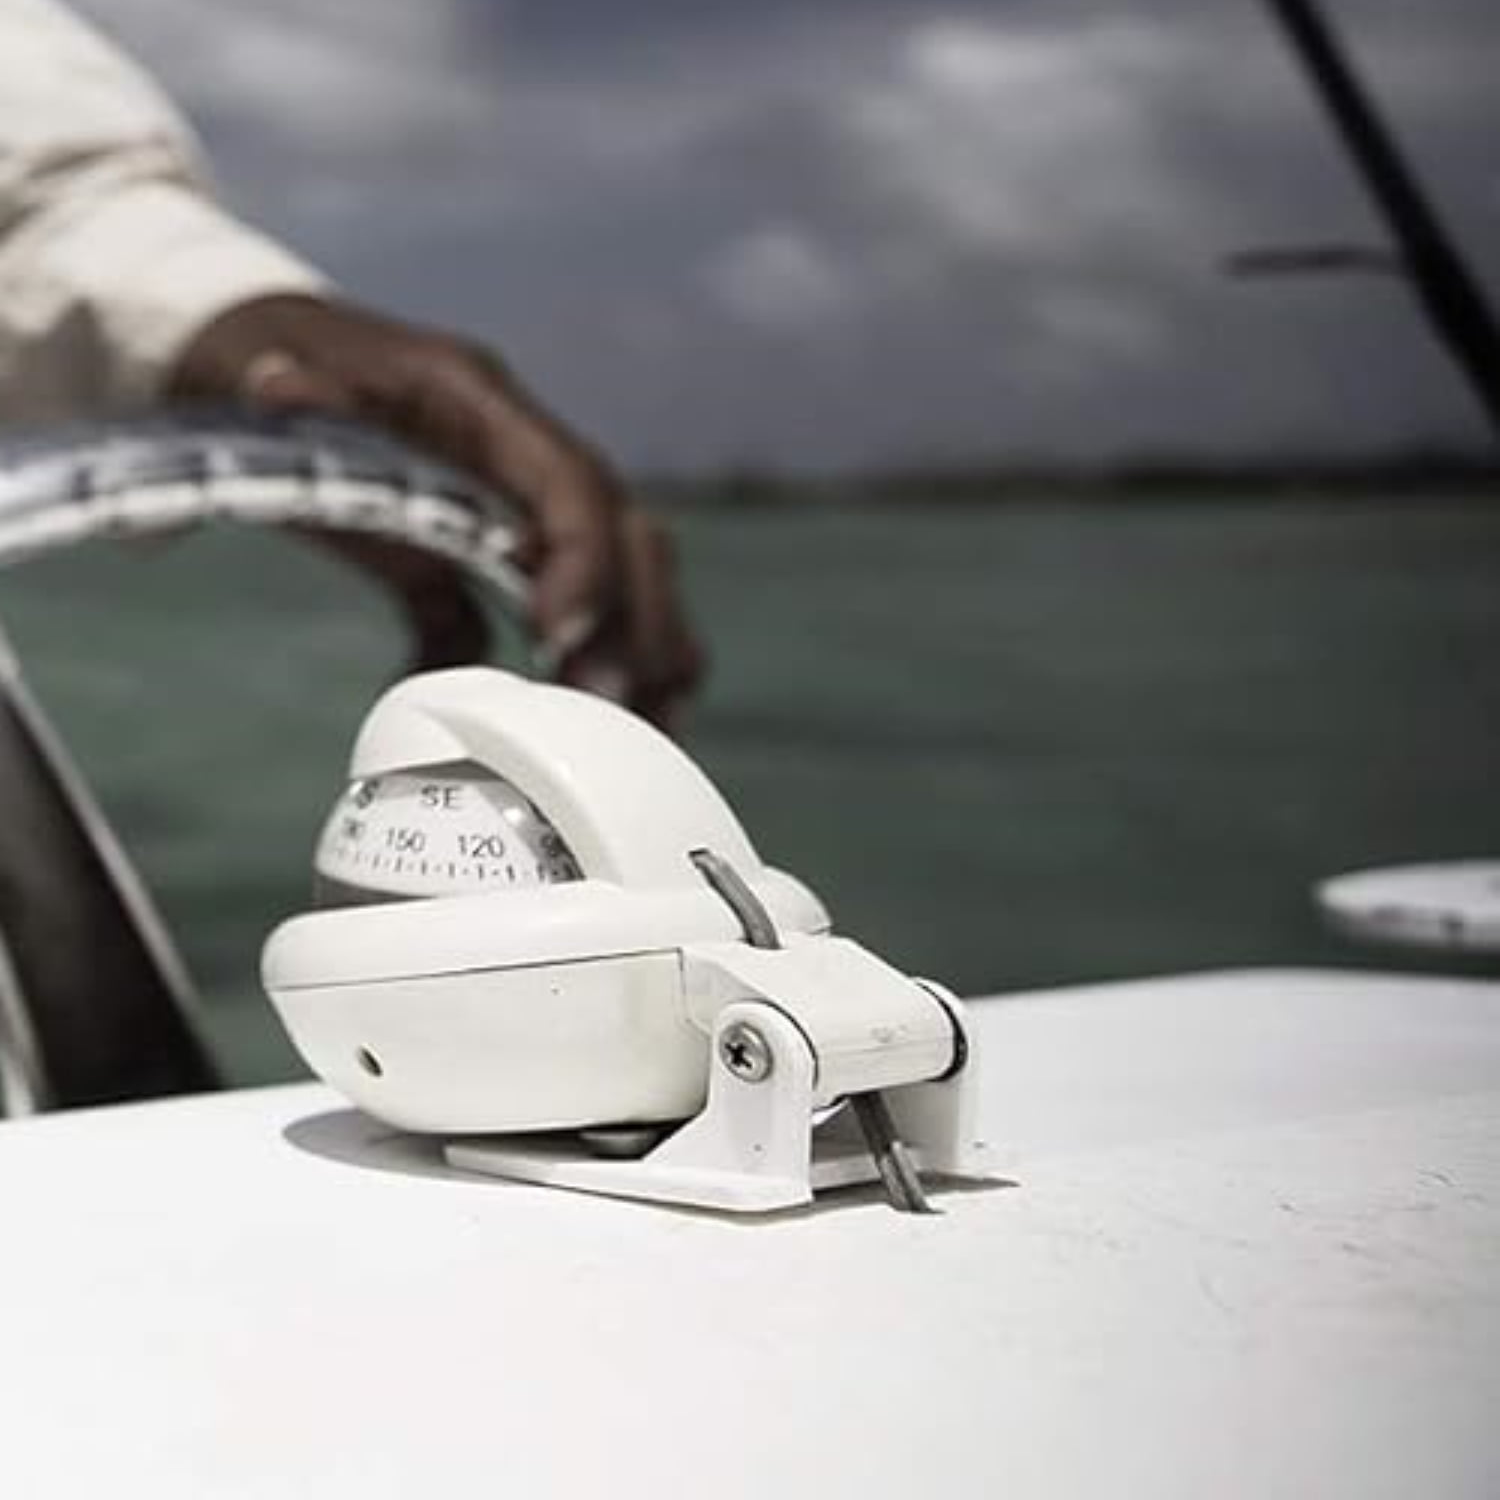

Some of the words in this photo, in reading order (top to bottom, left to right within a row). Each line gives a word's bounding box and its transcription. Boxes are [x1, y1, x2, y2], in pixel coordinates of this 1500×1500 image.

[421, 784, 462, 808] SE
[386, 827, 426, 853] 150
[457, 834, 504, 859] 120
